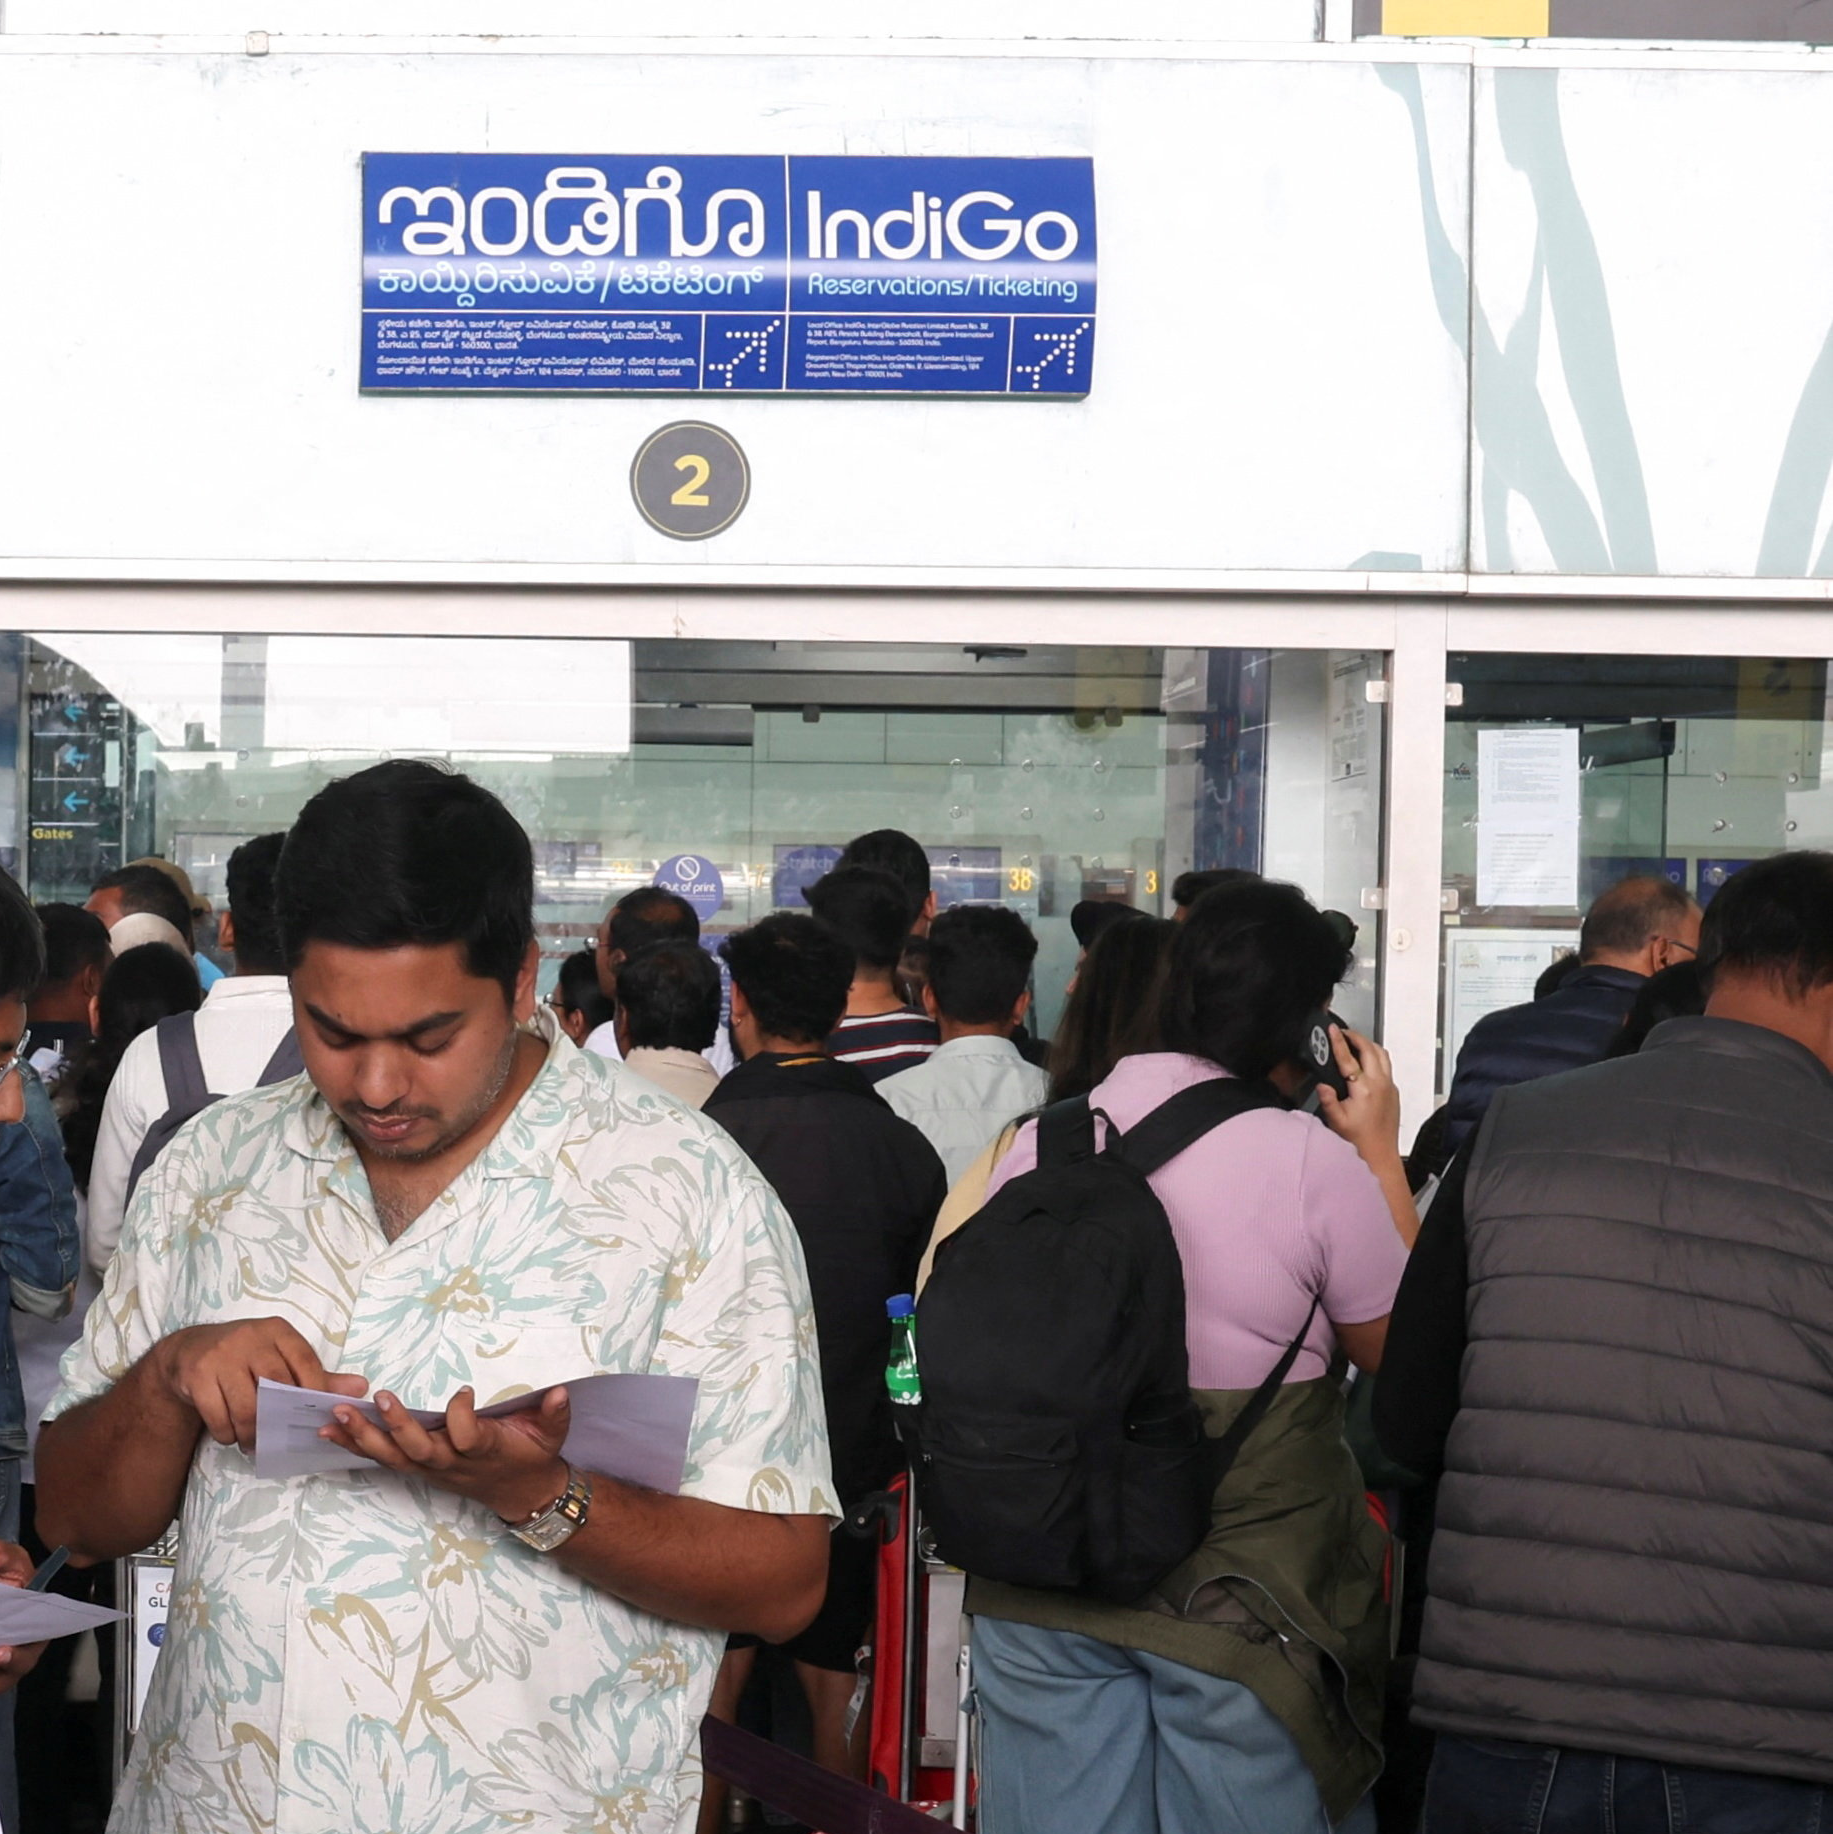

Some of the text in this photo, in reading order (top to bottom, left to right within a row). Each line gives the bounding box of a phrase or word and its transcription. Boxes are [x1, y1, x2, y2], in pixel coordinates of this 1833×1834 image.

[808, 190, 1079, 261] IndiGo
[808, 271, 1079, 303] Reservations/Ticketing
[671, 454, 710, 506] 2
[32, 827, 74, 840] Gates
[680, 881, 691, 892] of
[692, 881, 716, 895] print
[1008, 866, 1032, 891] 38
